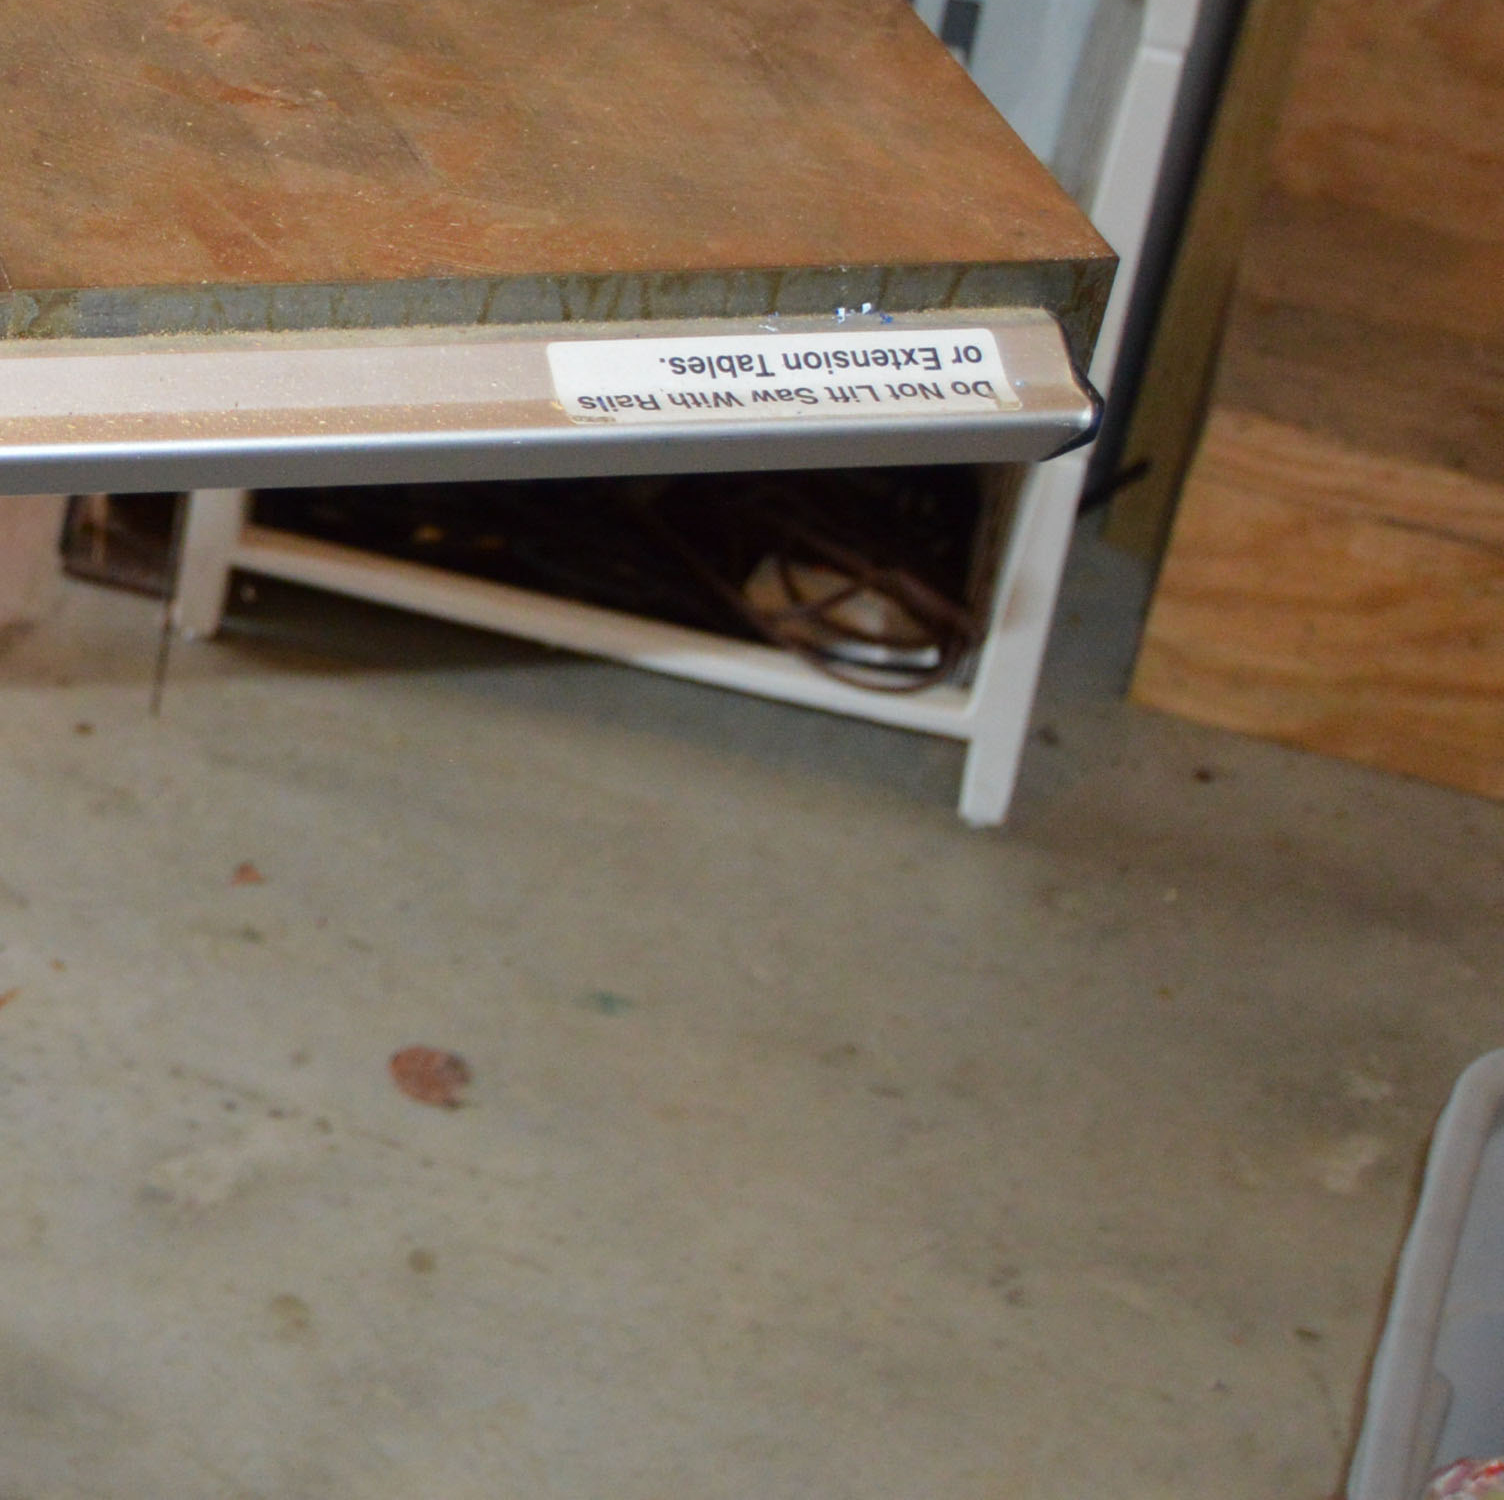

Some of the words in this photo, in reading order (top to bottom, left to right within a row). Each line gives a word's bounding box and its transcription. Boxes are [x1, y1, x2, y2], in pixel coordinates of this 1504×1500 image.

[658, 351, 775, 378] Tables.
[782, 346, 942, 372] Extension
[953, 344, 983, 365] or
[665, 387, 745, 407] With
[751, 386, 818, 405] Saw
[827, 383, 880, 403] Lift
[889, 382, 943, 401] Not
[951, 379, 994, 398] Do
[577, 391, 662, 412] Rails
